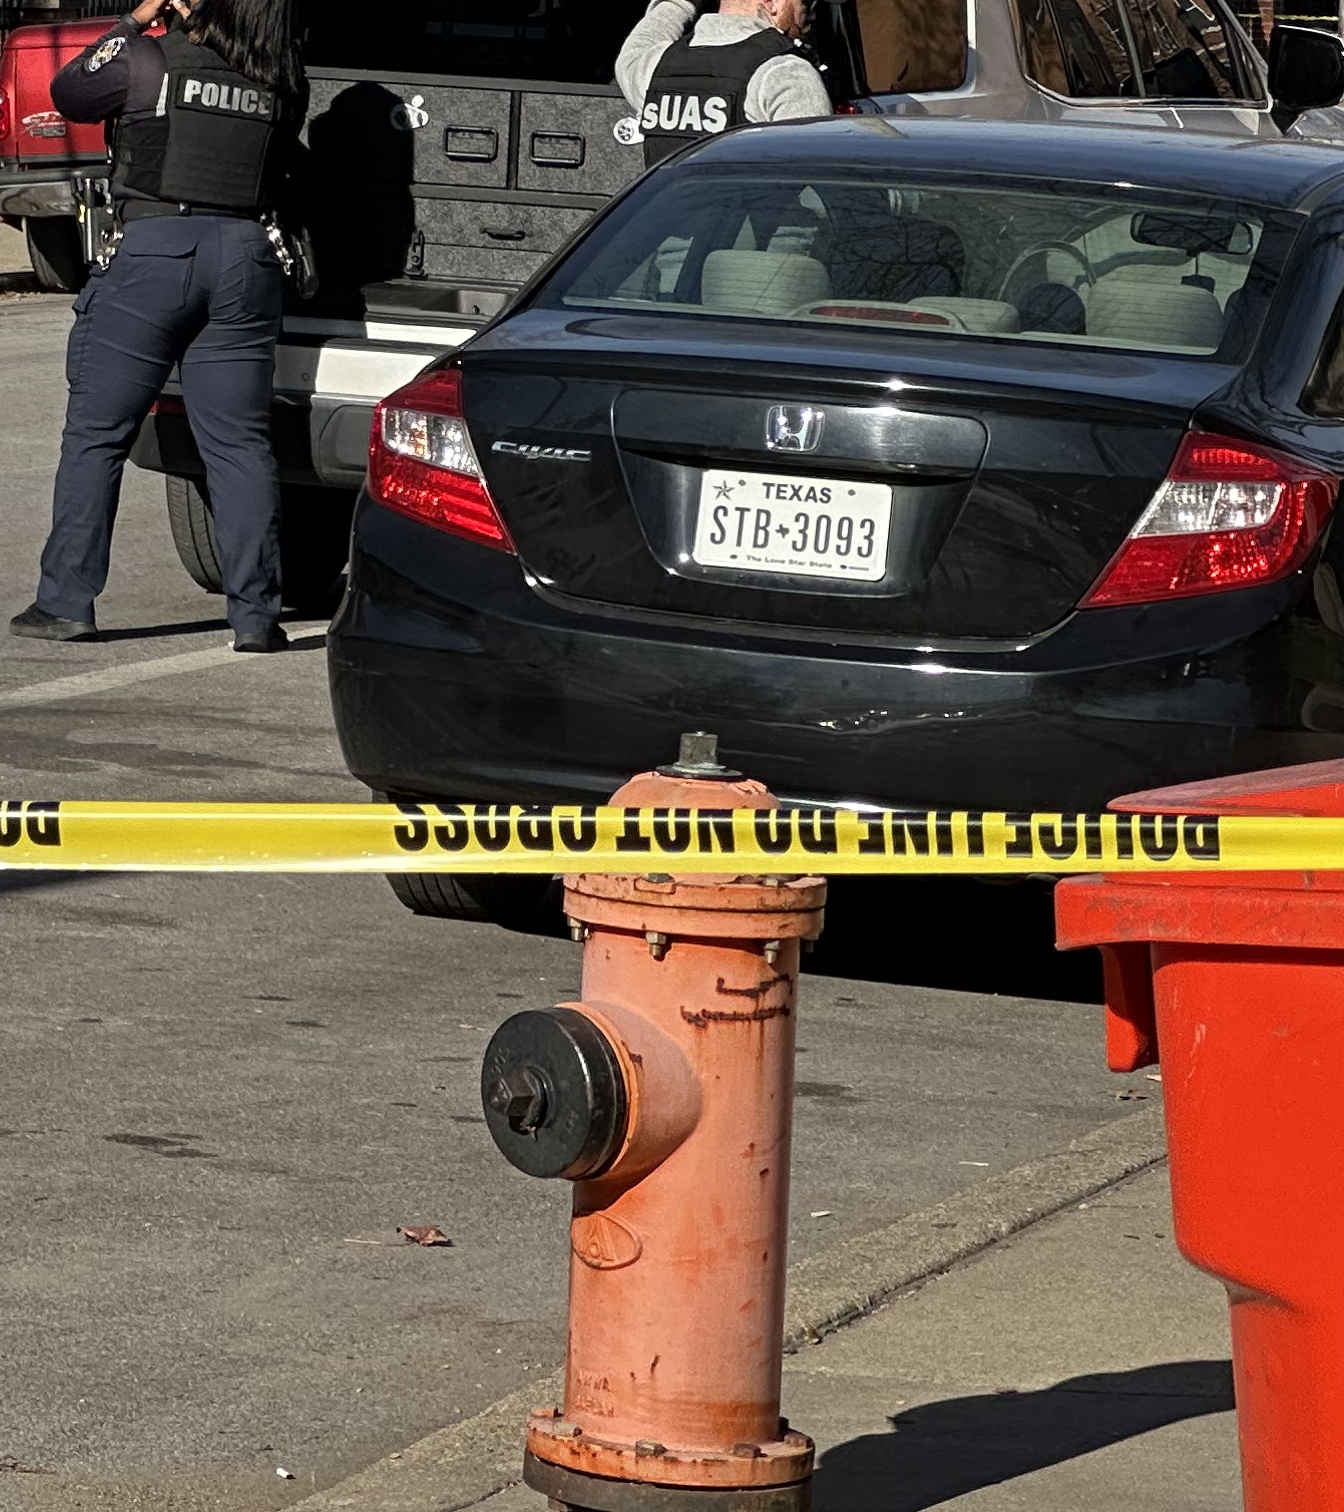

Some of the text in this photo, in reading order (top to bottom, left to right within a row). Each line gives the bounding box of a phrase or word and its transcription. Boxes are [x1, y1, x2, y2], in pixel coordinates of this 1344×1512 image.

[183, 79, 271, 114] POLICE
[762, 482, 832, 504] TEXAS
[710, 505, 875, 558] STB 3093
